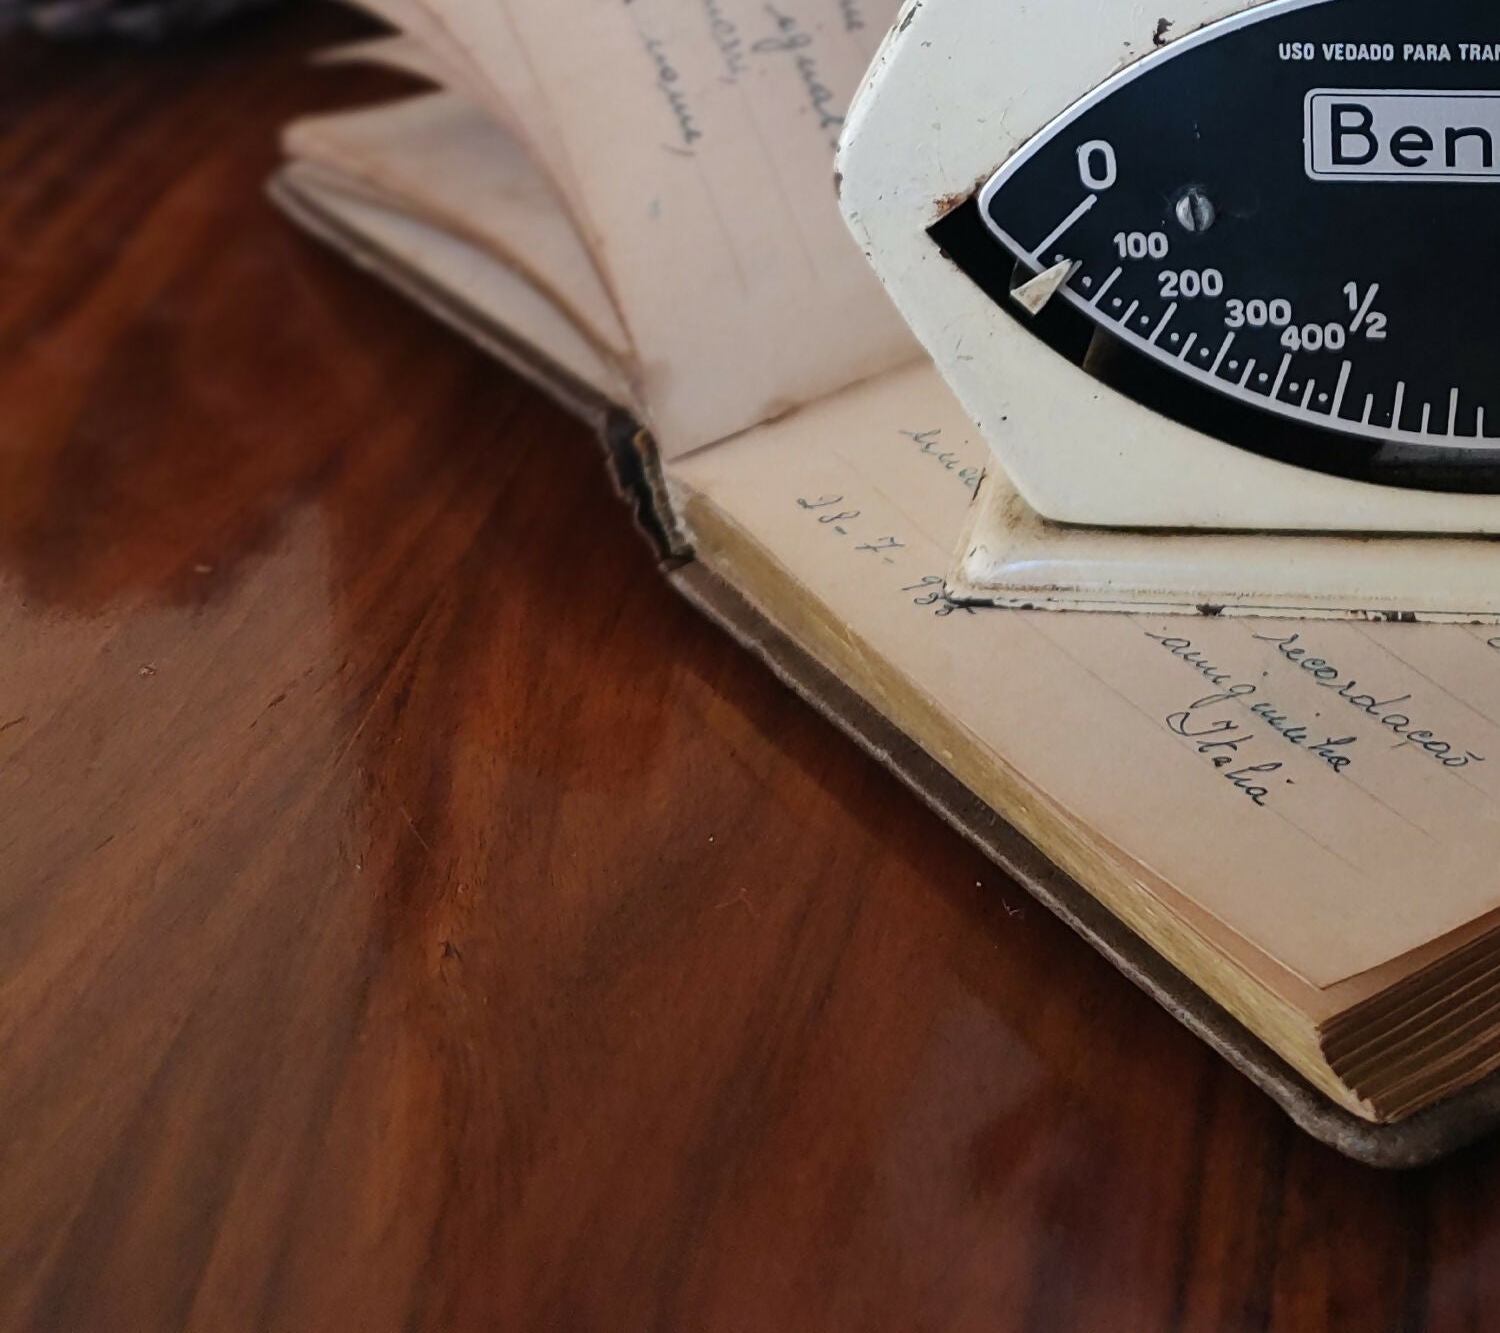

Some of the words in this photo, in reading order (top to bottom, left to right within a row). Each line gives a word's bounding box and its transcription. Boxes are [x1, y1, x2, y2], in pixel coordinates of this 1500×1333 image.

[1278, 43, 1315, 62] USO
[1322, 44, 1395, 62] VEDADO
[1403, 44, 1452, 62] PARA
[1077, 139, 1118, 190] 0
[1112, 231, 1169, 259] 100
[1157, 268, 1224, 298] 200
[1224, 299, 1292, 328] 300
[1280, 323, 1346, 351] 400
